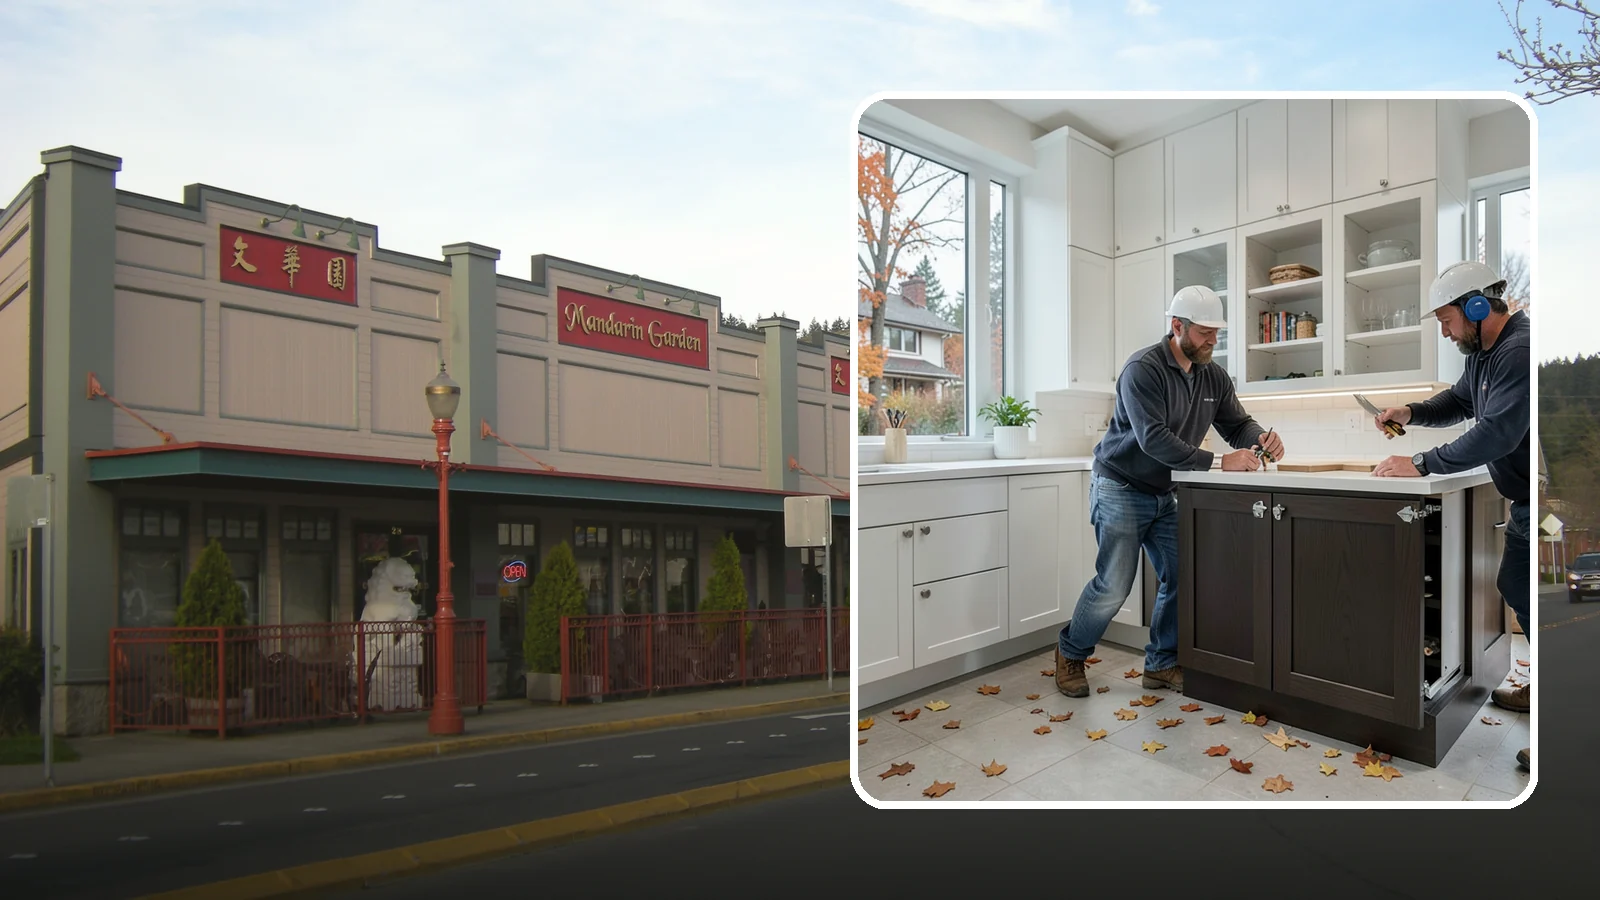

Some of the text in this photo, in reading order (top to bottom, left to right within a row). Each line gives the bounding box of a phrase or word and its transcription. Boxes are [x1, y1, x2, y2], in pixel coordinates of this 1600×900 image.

[231, 236, 346, 290] 文華園
[564, 302, 701, 352] Mandarin Garden
[834, 363, 846, 386] 文
[504, 565, 527, 579] OPEN
